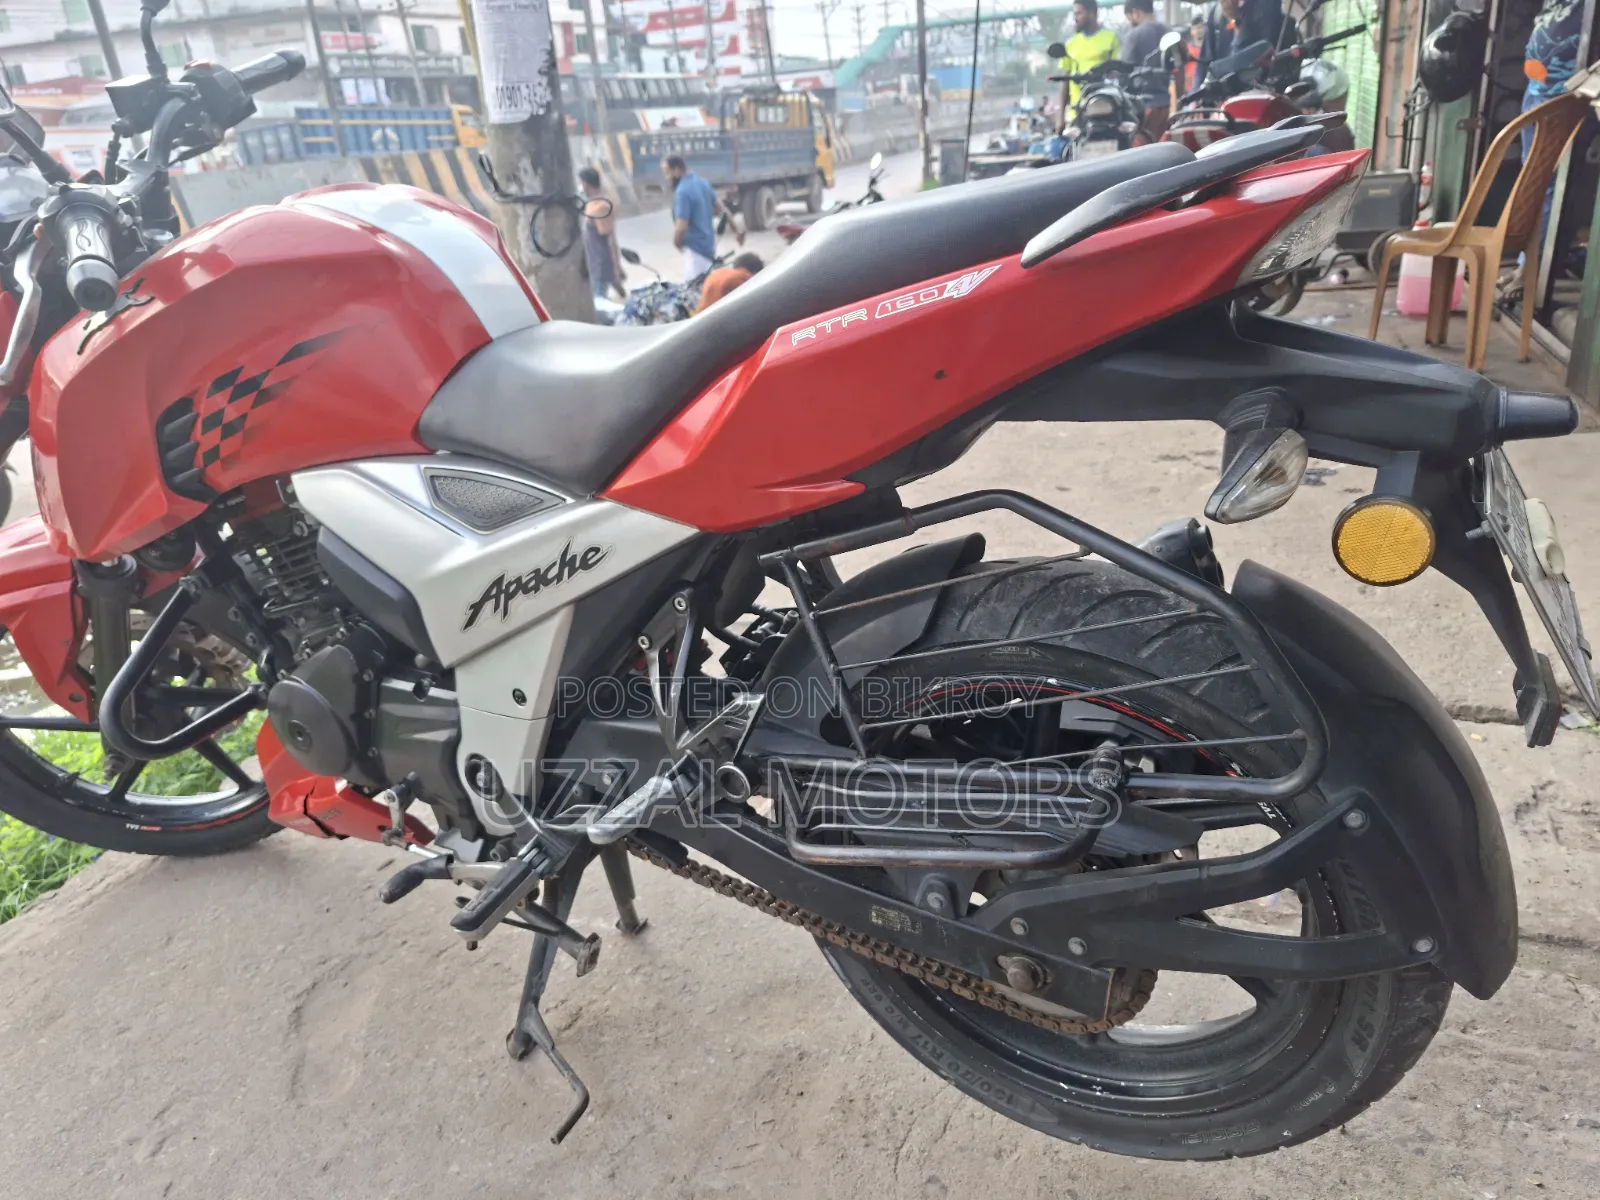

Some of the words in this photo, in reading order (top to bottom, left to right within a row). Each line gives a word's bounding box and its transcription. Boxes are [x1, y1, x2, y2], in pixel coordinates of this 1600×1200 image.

[791, 308, 868, 346] RTR
[885, 288, 939, 311] 160
[462, 538, 610, 631] Apache
